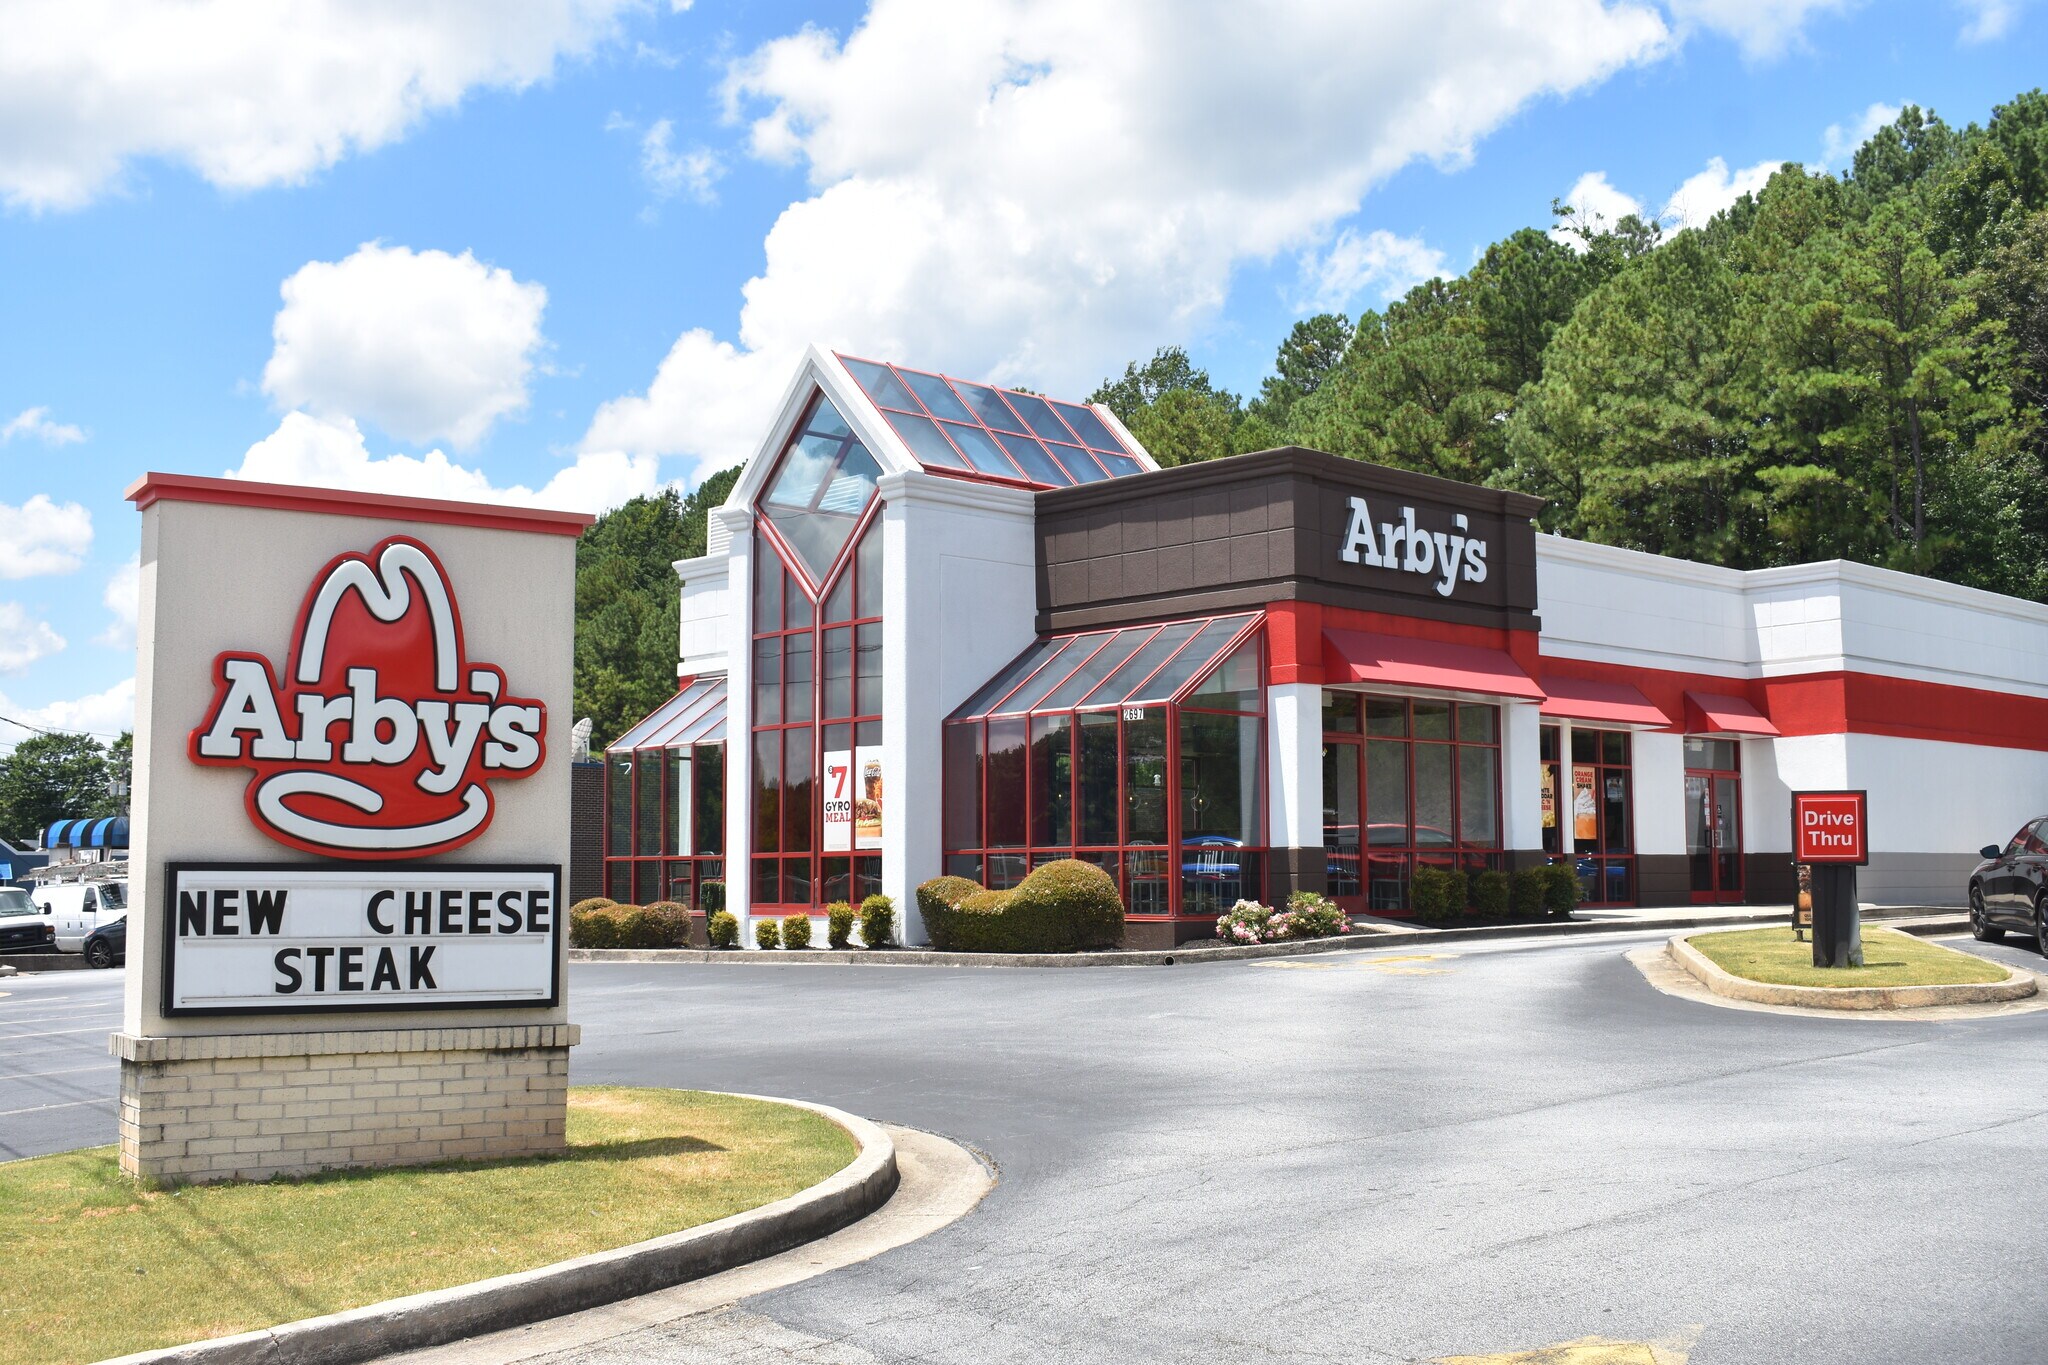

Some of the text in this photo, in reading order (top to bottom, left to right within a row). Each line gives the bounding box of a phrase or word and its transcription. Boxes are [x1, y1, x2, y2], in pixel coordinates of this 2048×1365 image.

[1339, 497, 1488, 597] Arby's
[1124, 709, 1142, 720] 2697
[201, 660, 541, 793] Arby's
[825, 801, 850, 812] GYRO
[825, 812, 851, 823] MEAL
[1804, 811, 1855, 826] Drive
[1808, 831, 1853, 846] Thru
[179, 889, 551, 937] NEW CHEESE
[274, 945, 438, 995] STEAK
